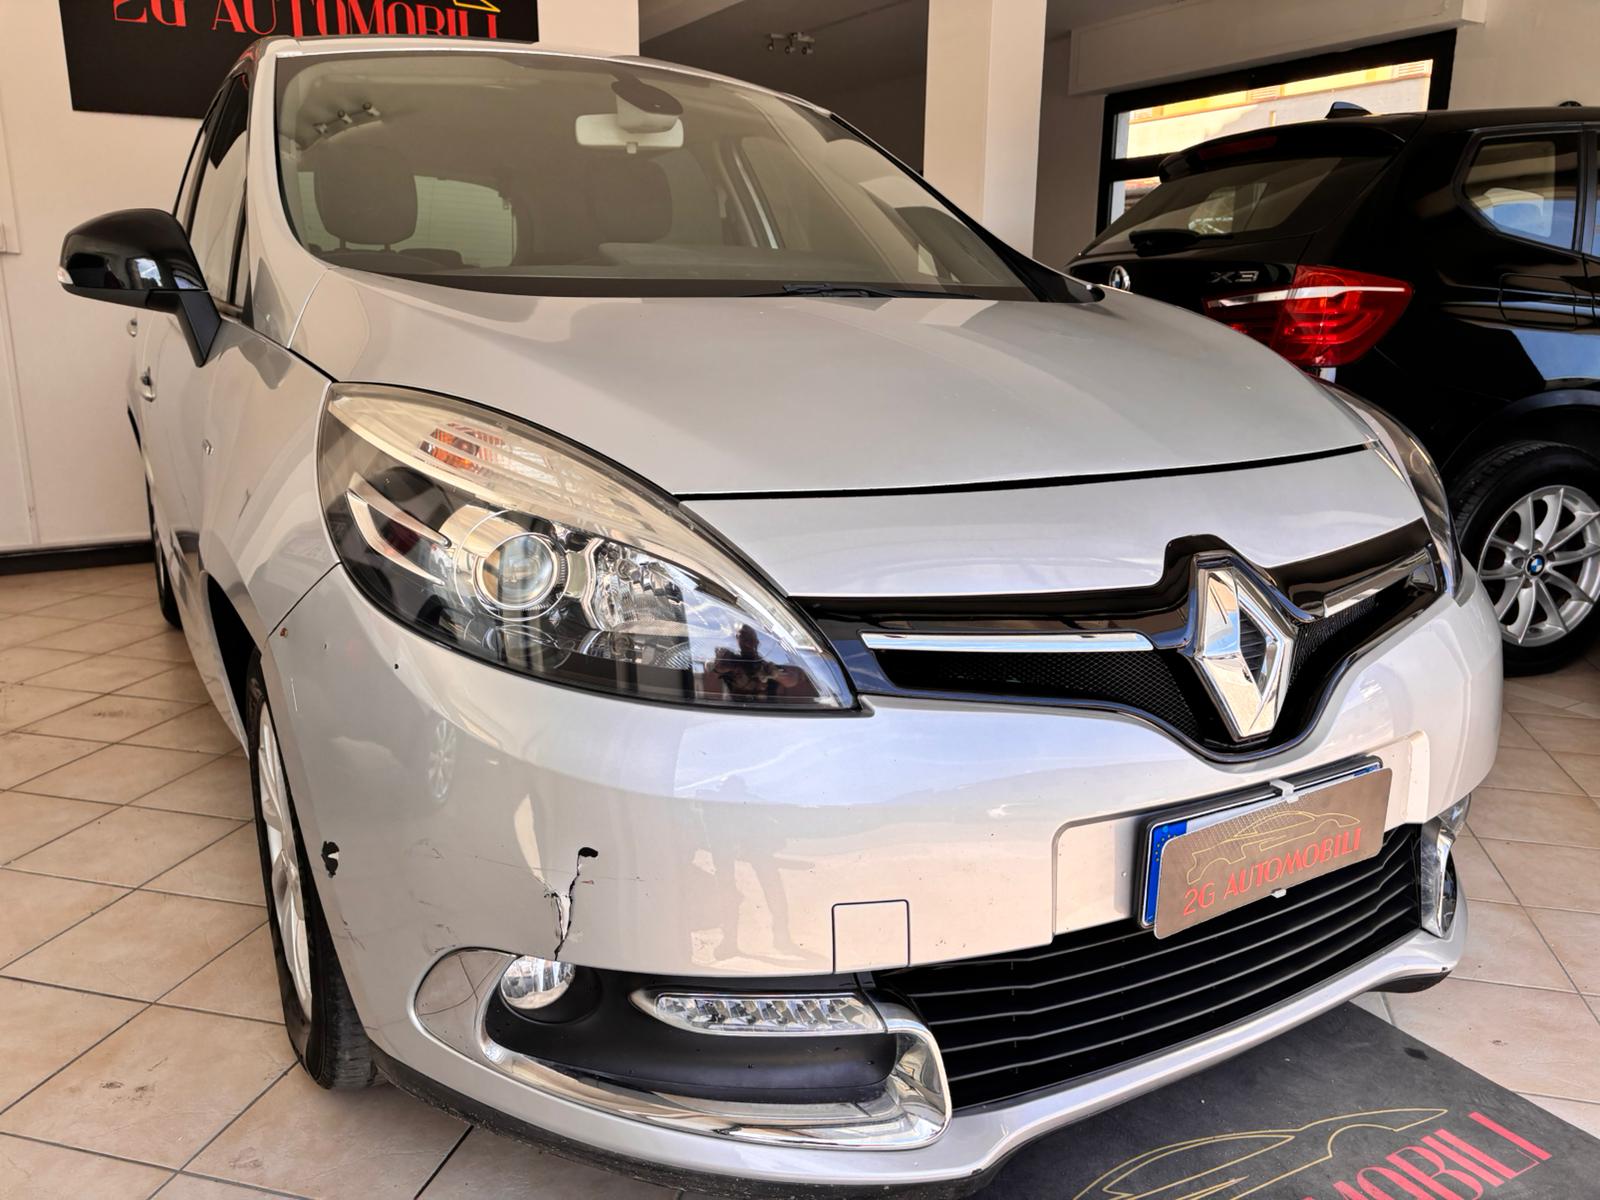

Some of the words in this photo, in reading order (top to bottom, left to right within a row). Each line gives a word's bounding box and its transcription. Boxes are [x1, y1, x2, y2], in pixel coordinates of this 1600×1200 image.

[1209, 270, 1259, 284] X3
[1182, 881, 1216, 916] 2G
[1223, 827, 1363, 900] AUTOMOBILI
